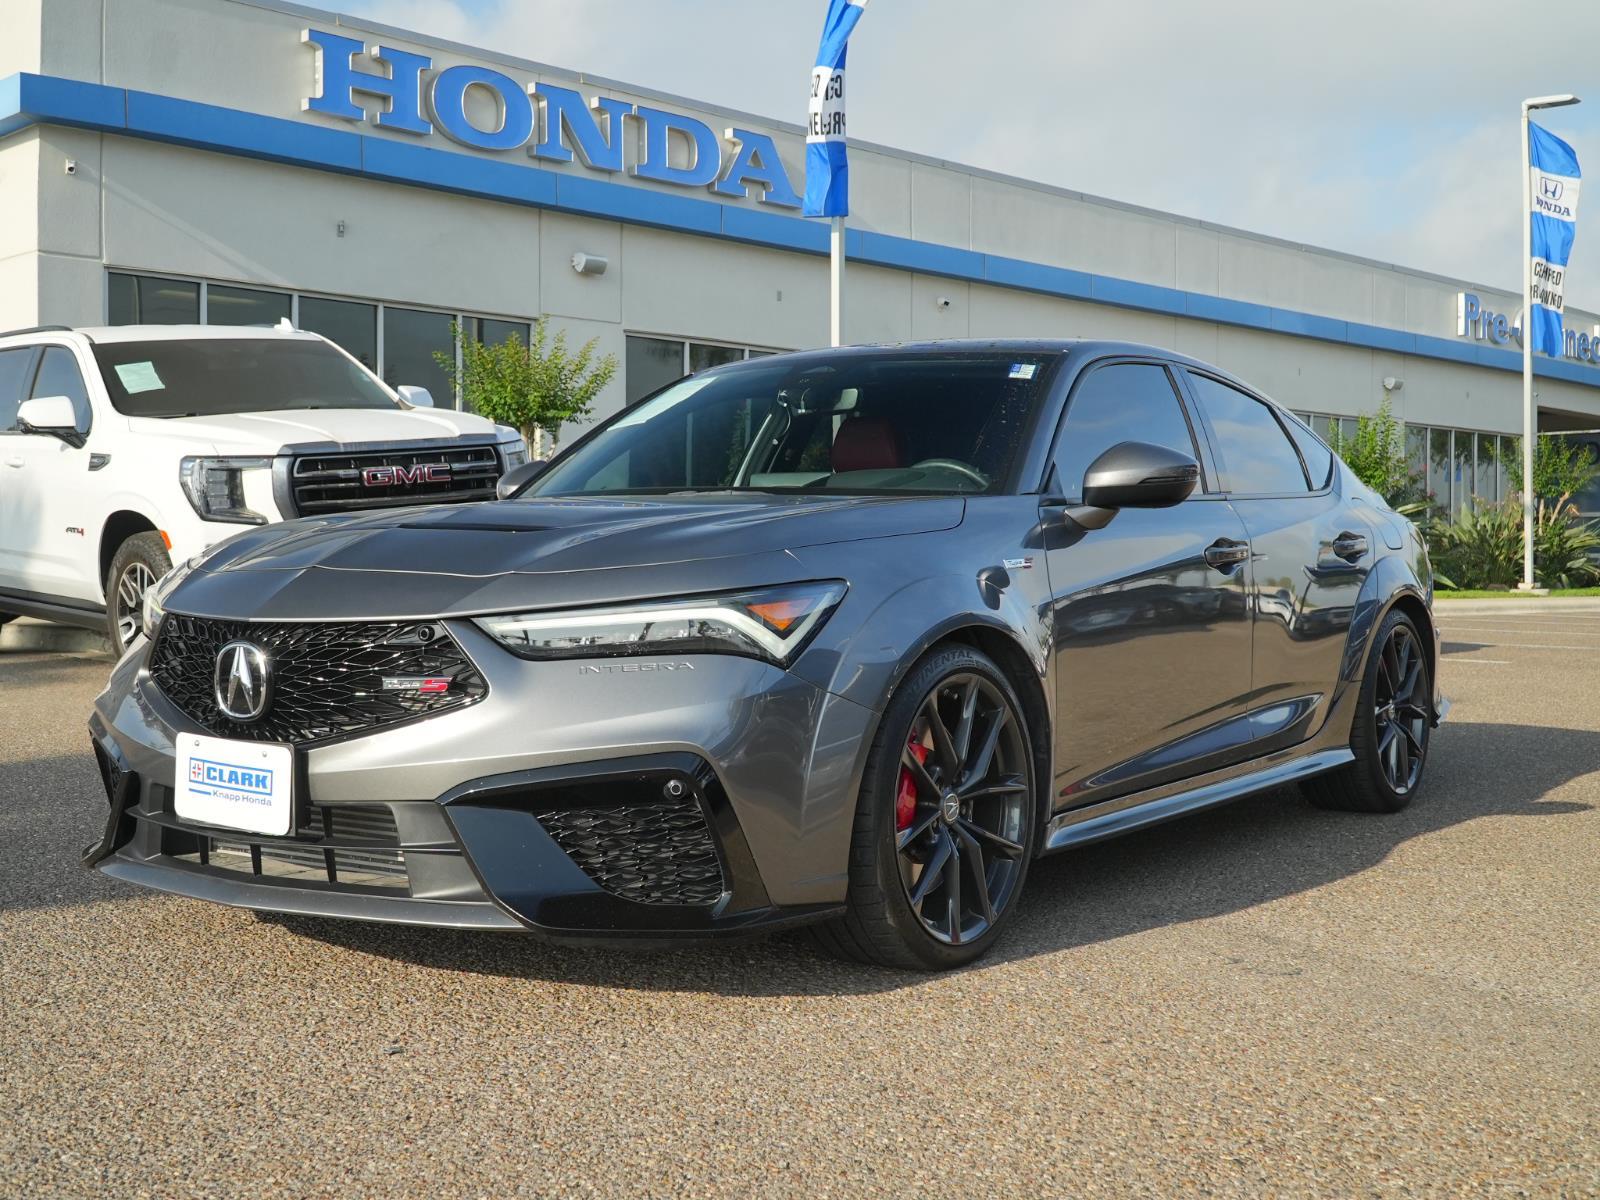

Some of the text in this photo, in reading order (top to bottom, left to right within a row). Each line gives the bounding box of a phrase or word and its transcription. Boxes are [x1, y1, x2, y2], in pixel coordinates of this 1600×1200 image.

[301, 28, 804, 208] HONDA
[361, 463, 451, 486] GMC
[579, 661, 695, 675] INTEGRA
[206, 766, 268, 789] CLARK
[212, 789, 272, 807] Knapp Honda
